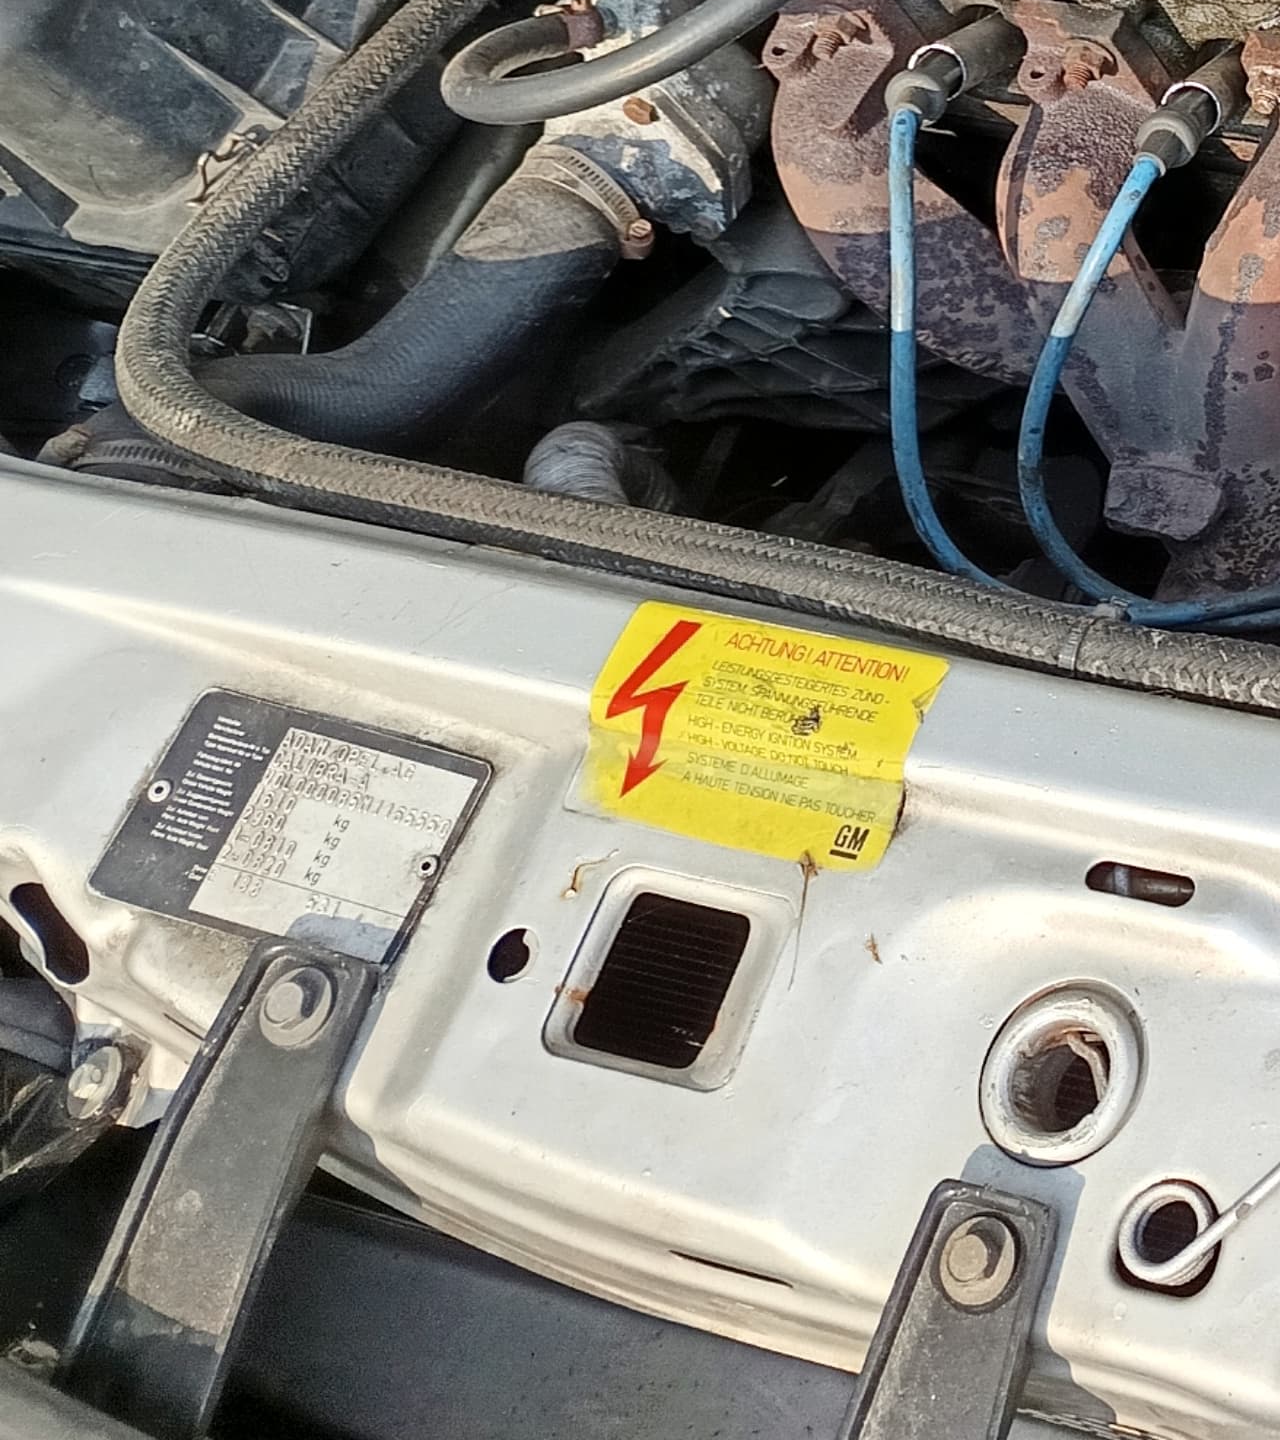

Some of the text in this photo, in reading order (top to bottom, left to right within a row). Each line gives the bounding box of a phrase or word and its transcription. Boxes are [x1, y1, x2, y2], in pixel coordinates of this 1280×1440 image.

[725, 631, 911, 683] ACHTUNG! ATTENTION!
[695, 692, 724, 710] TEILE
[728, 698, 760, 717] NICHT
[688, 714, 715, 730] HIGH
[721, 724, 766, 742] ENERGY
[768, 732, 812, 751] IGNITION
[688, 732, 714, 746] HIGH
[271, 749, 371, 792] CALIBRA-A
[281, 730, 330, 757] ADAM
[336, 744, 383, 772] OPEL
[393, 762, 417, 783] AG
[252, 783, 298, 813] 1610
[333, 814, 351, 832] kg
[693, 773, 730, 792] HAUTE
[733, 780, 781, 804] TENSION
[780, 792, 799, 807] NE
[798, 796, 822, 812] PAS
[823, 801, 877, 824] TOUCHER
[240, 806, 288, 833] 2960
[323, 832, 341, 850] kg
[833, 824, 871, 853] GM
[304, 867, 322, 886] kg
[313, 850, 331, 868] kg
